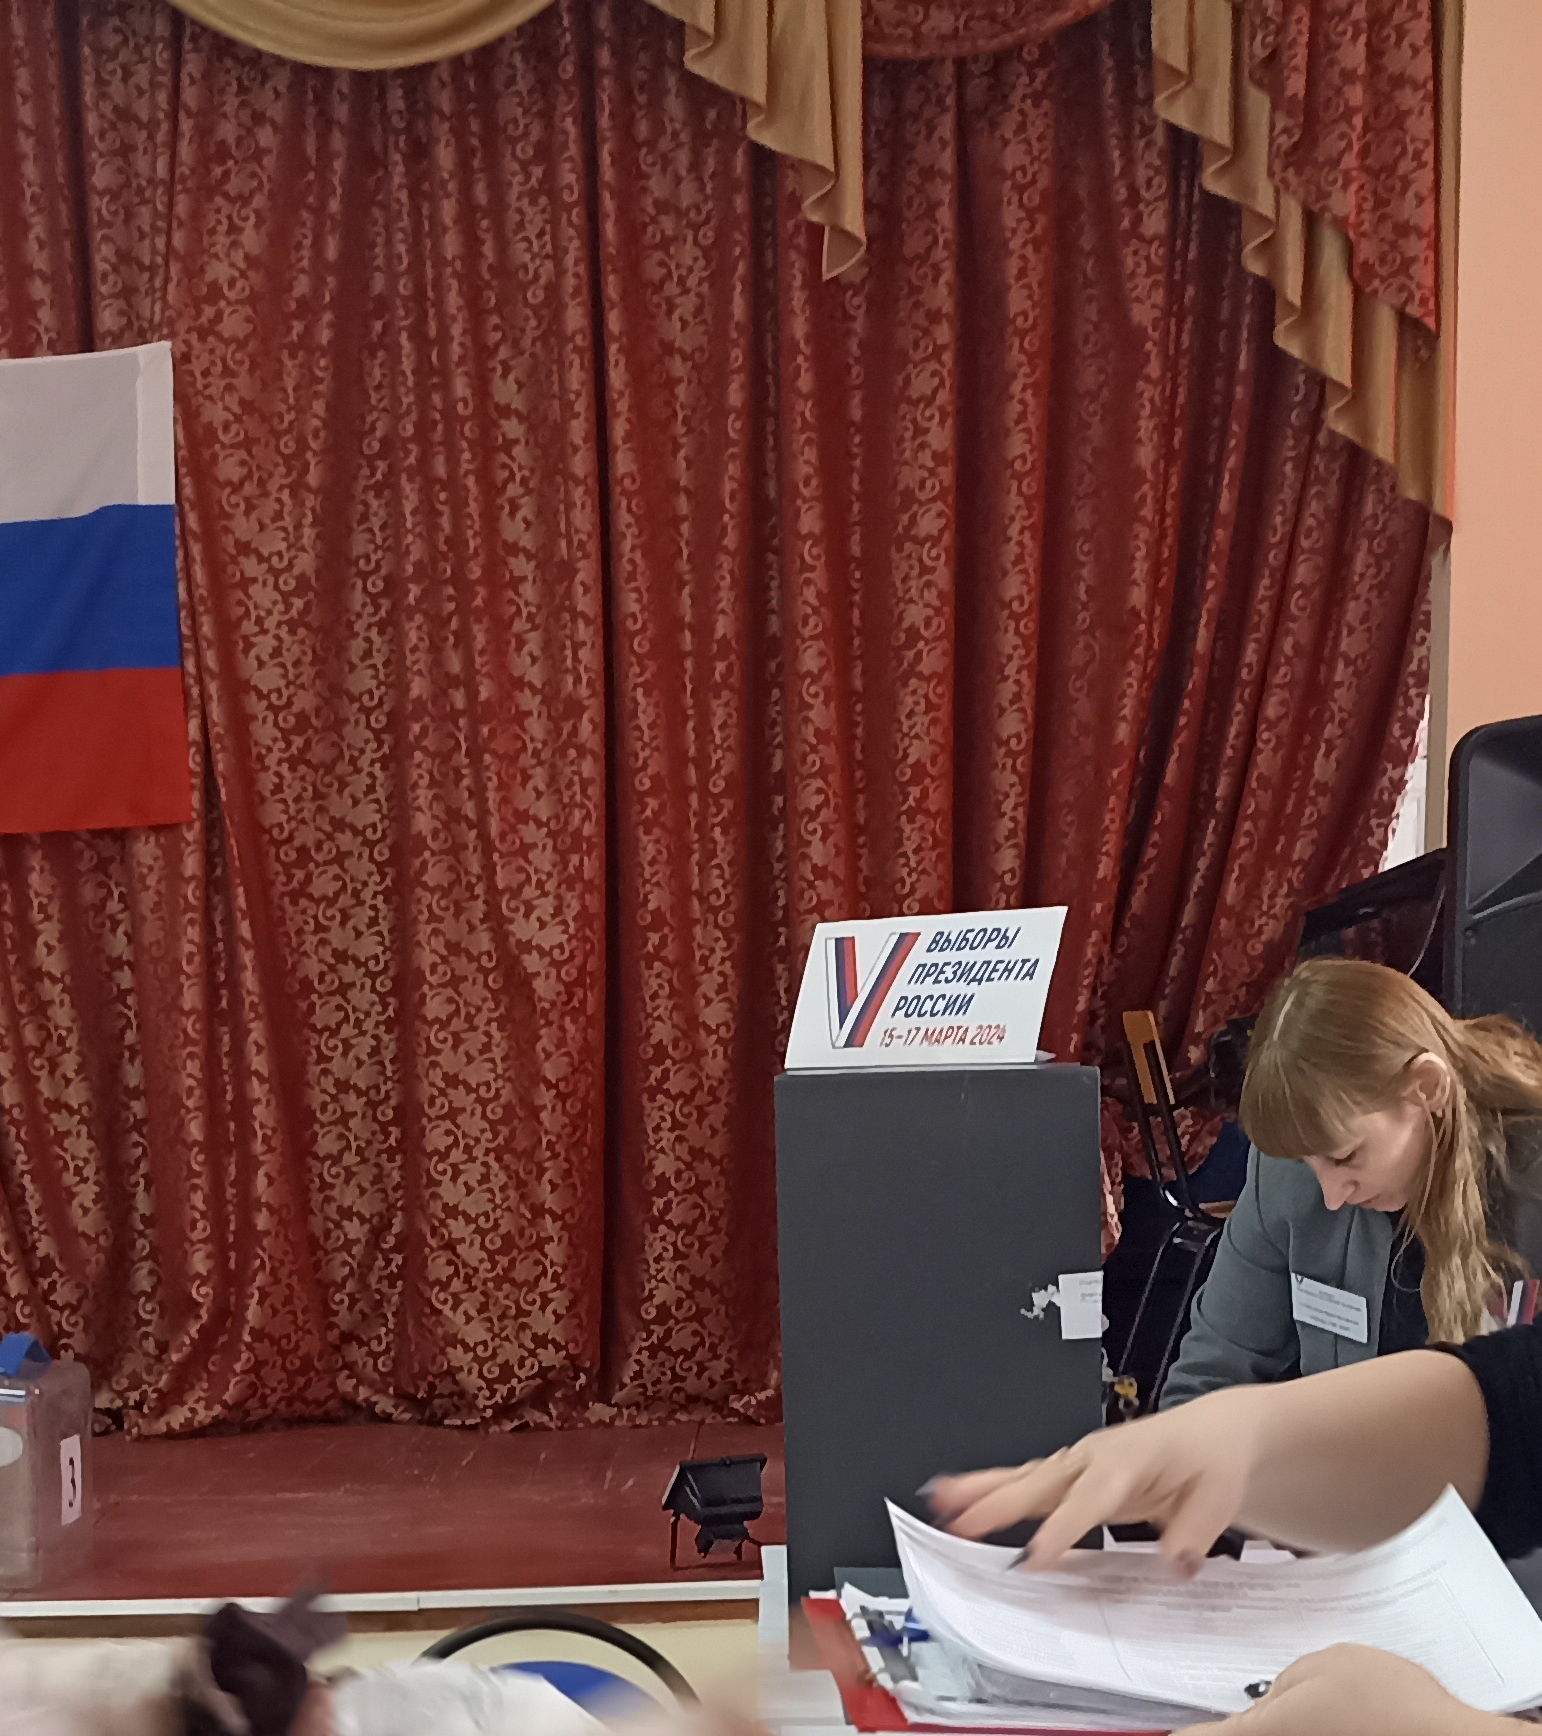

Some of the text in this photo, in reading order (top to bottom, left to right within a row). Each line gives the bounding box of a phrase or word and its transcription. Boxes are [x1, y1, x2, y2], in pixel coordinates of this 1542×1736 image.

[926, 927, 1021, 953] ВЫБОРЫ
[907, 958, 1040, 987] ПРЕЗИДЕНТА
[891, 993, 975, 1018] РОССИИ
[920, 1025, 968, 1047] МАРТА
[969, 1023, 1007, 1046] 2024
